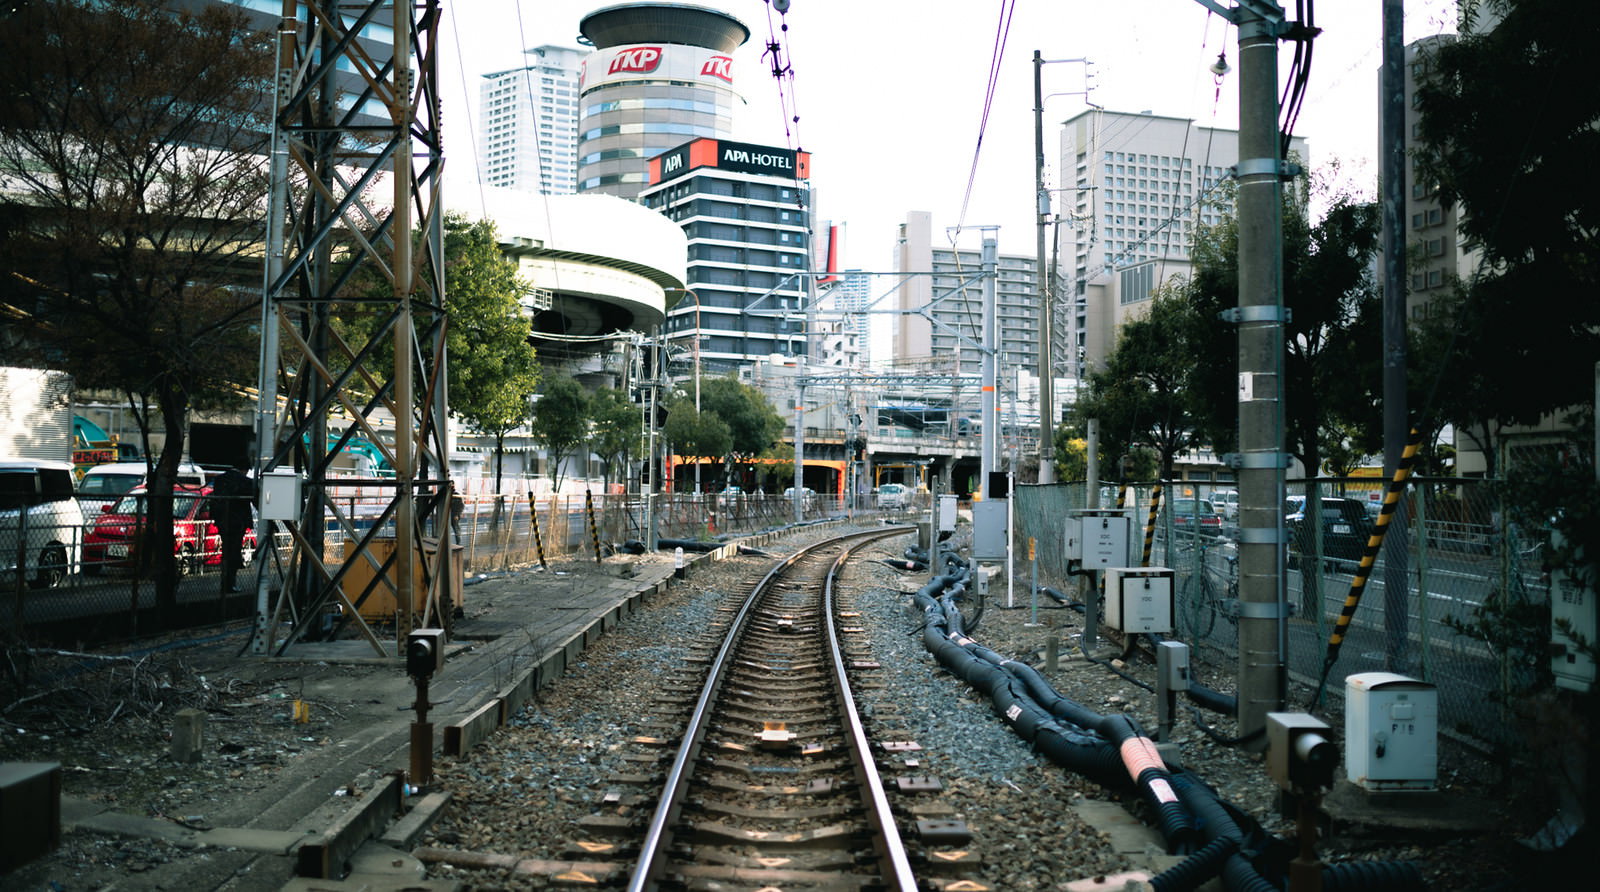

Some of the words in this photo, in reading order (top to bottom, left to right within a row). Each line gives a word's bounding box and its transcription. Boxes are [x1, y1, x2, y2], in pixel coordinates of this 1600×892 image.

[613, 48, 658, 70] TKP
[664, 153, 683, 174] APA
[724, 149, 750, 164] APA
[751, 153, 793, 169] HOTEL
